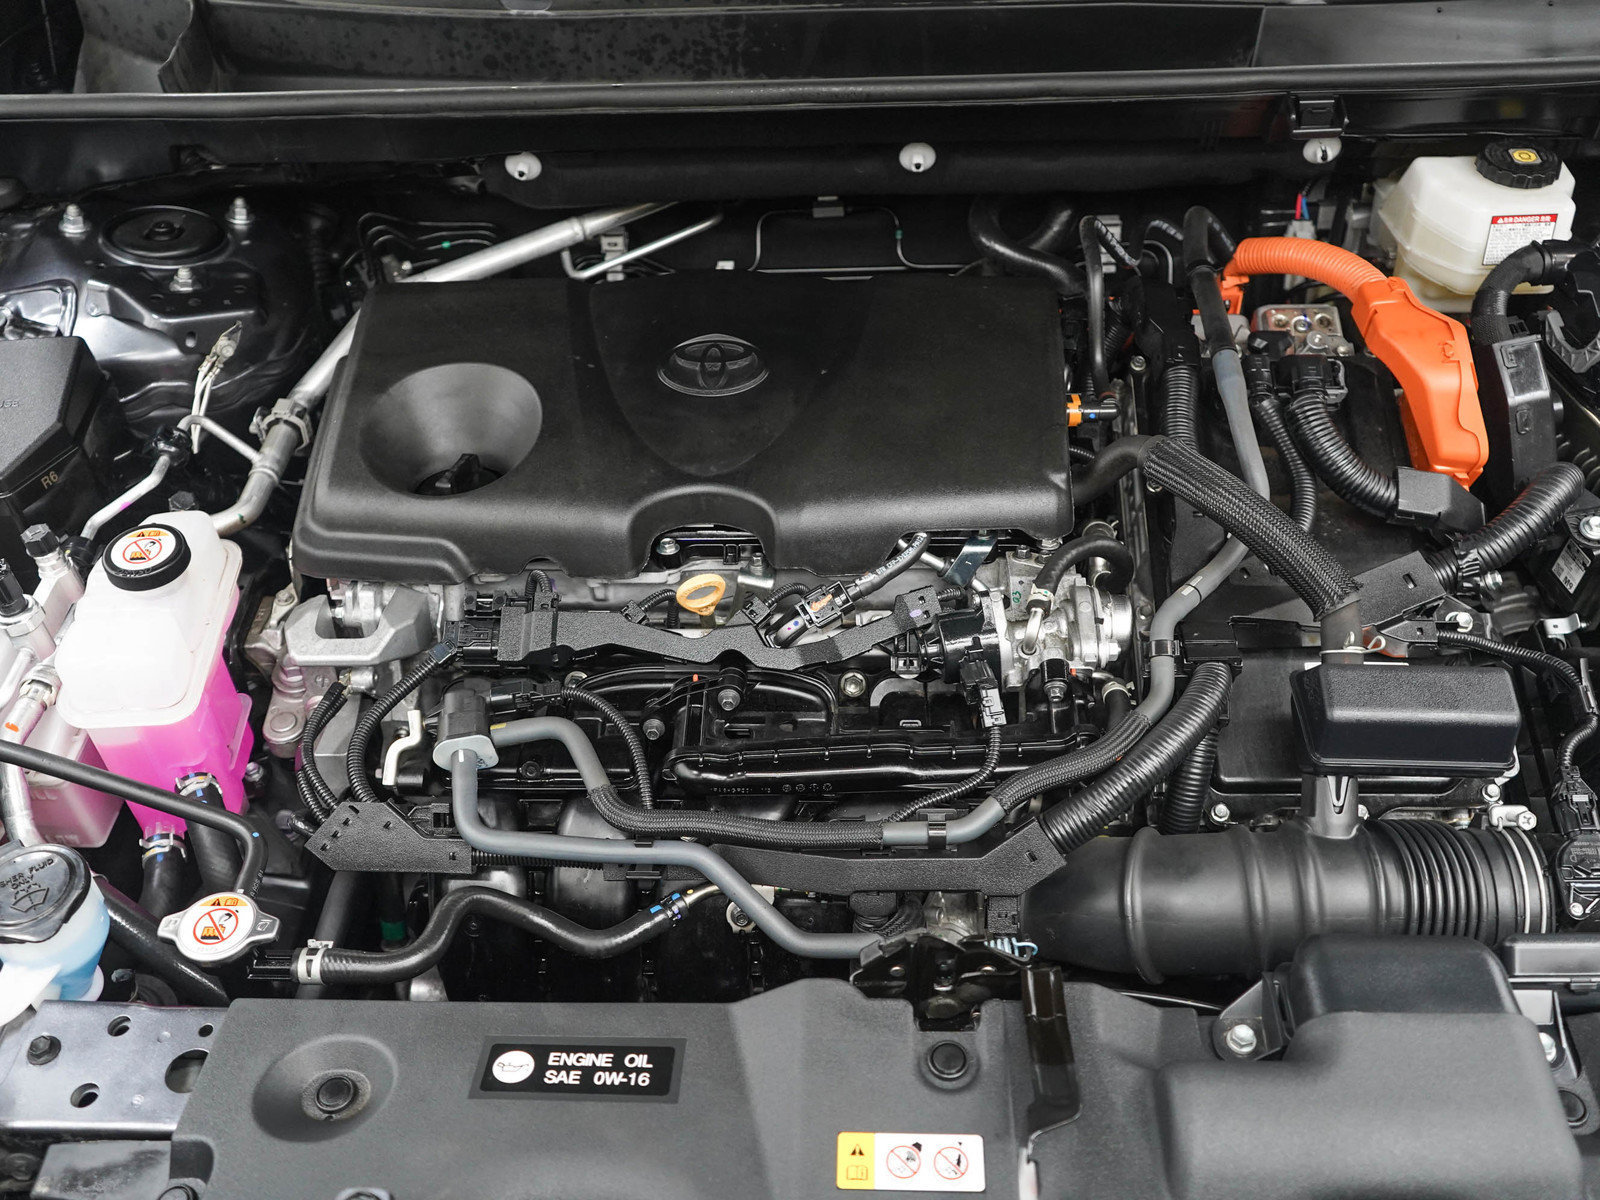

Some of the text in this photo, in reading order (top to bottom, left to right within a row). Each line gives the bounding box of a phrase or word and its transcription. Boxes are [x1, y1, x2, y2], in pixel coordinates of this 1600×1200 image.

[41, 471, 59, 489] R6
[28, 858, 54, 874] FLUID
[11, 874, 34, 890] ONLY
[547, 1052, 653, 1068] ENGINE OIL
[543, 1070, 651, 1087] SAE 0W-16
